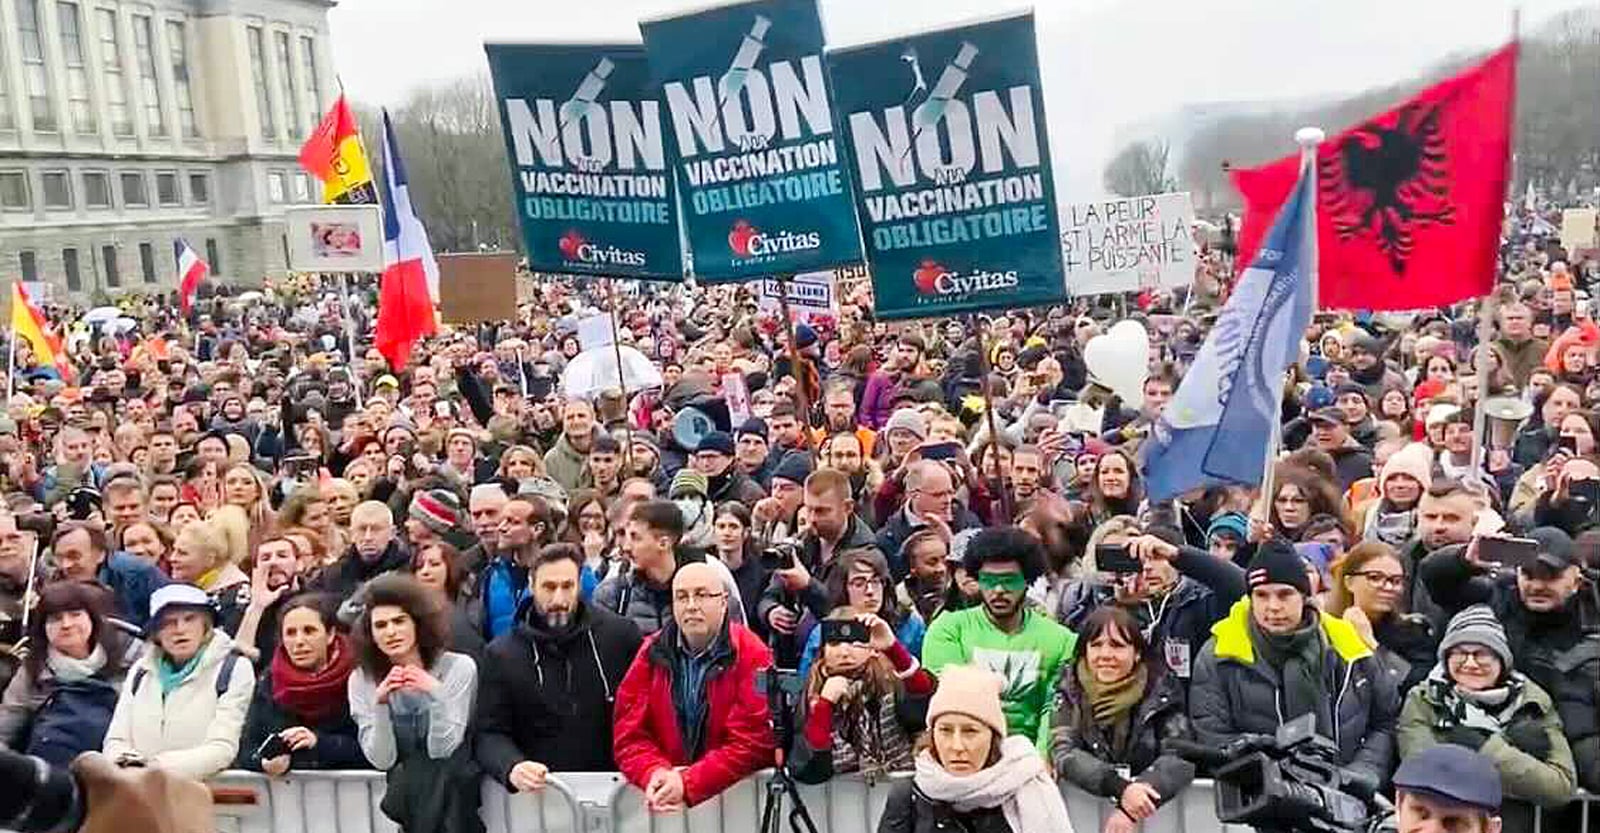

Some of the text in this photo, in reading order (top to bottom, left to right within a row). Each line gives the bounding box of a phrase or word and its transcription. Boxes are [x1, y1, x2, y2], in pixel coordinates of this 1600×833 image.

[664, 54, 833, 157] NON
[506, 98, 665, 170] NON
[849, 85, 1040, 191] NON
[684, 139, 837, 187] VACCINATION
[519, 171, 667, 199] VACCINATION
[692, 170, 843, 215] OBLIGATOIRE
[864, 173, 1044, 222] VACCINATION
[525, 197, 669, 224] OBLIGATOIRE
[872, 205, 1048, 251] OBLIGATOIRE
[1072, 197, 1156, 227] LA PEUR
[747, 230, 820, 255] Civitas
[1061, 230, 1081, 253] ST
[1160, 217, 1188, 242] LA
[577, 243, 646, 266] Civitas
[1088, 240, 1184, 271] PUISSANTE
[934, 268, 1019, 294] Civitas
